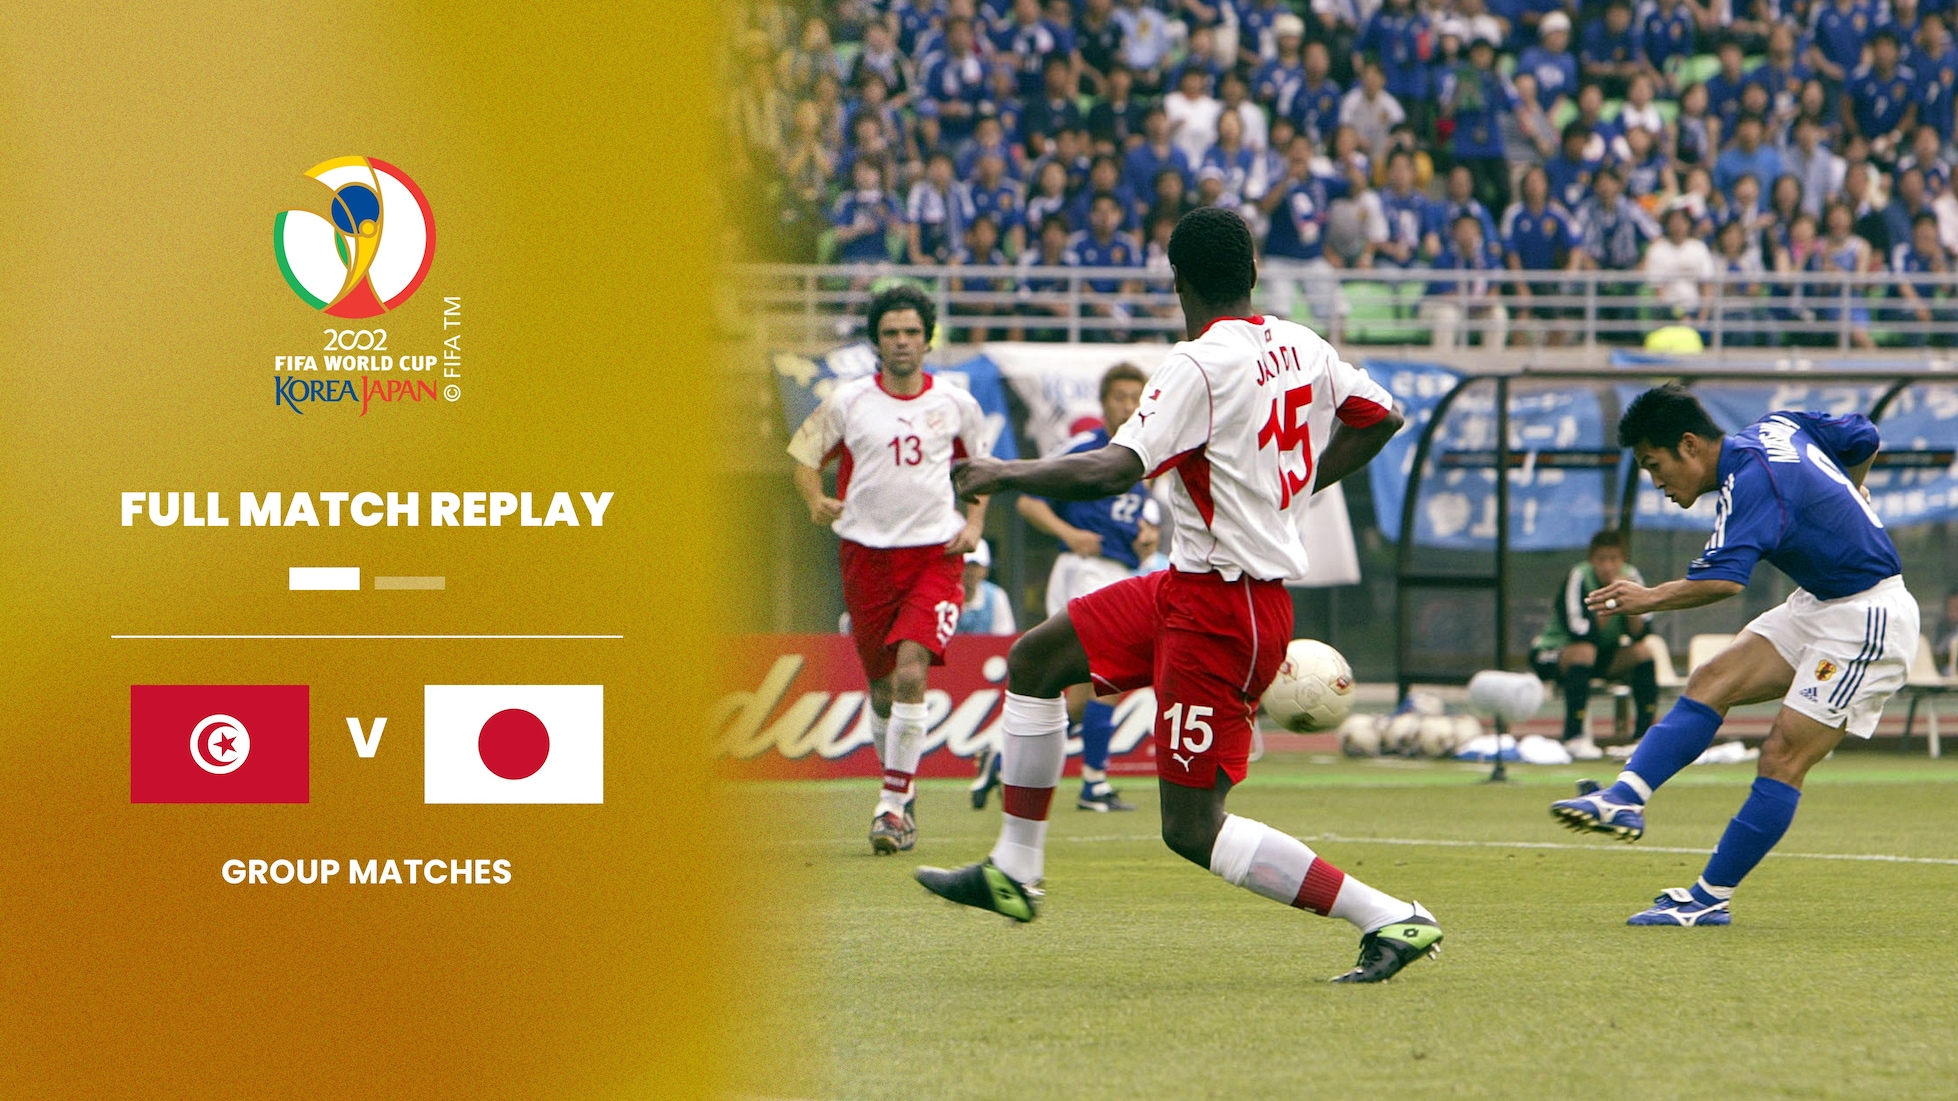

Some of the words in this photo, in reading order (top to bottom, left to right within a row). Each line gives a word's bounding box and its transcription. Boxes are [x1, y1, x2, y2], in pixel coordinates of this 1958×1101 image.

[887, 434, 923, 467] 13
[1258, 383, 1313, 511] 15
[1111, 493, 1141, 523] 22
[934, 600, 959, 637] 13
[1163, 702, 1214, 754] 15
